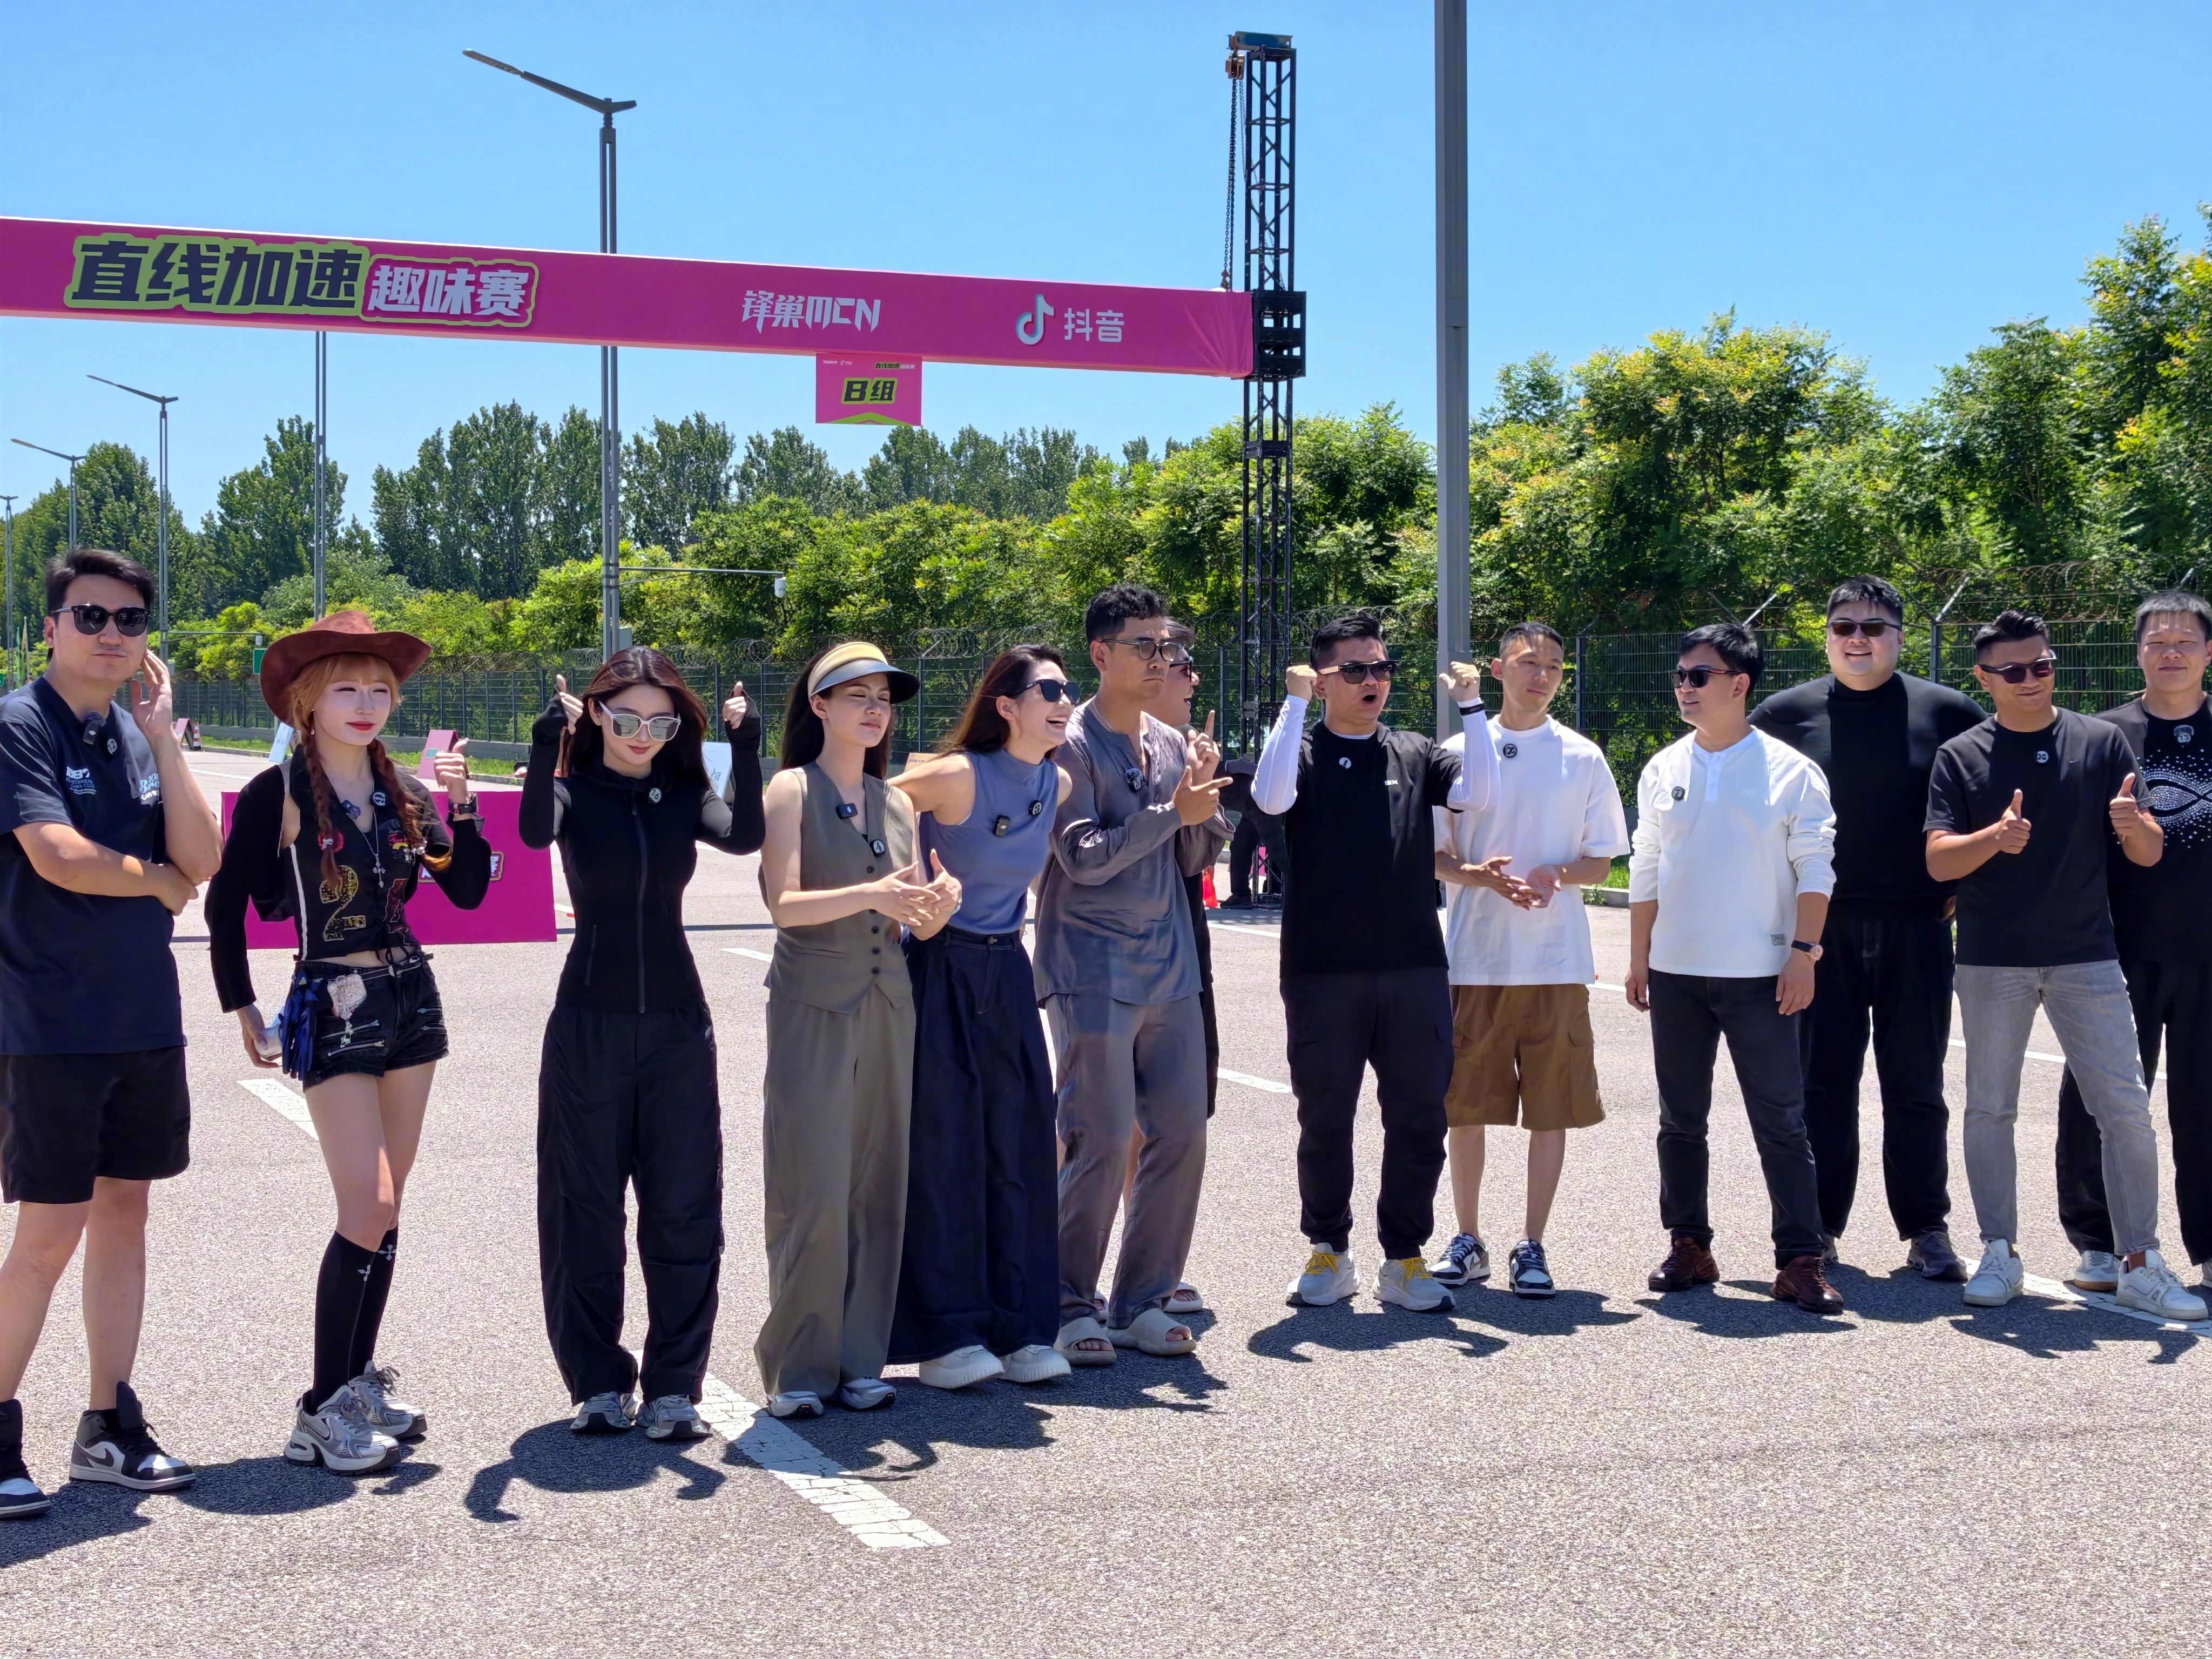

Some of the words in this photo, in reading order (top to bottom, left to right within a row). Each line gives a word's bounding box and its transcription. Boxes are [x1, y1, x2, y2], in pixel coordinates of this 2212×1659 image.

[72, 241, 363, 308] 直线加速
[368, 266, 527, 316] 趣味赛
[742, 290, 881, 334] 锋巢MCN
[1064, 308, 1124, 342] 抖音
[844, 380, 895, 401] B组
[651, 790, 660, 800] 16
[1675, 788, 1681, 798] 7
